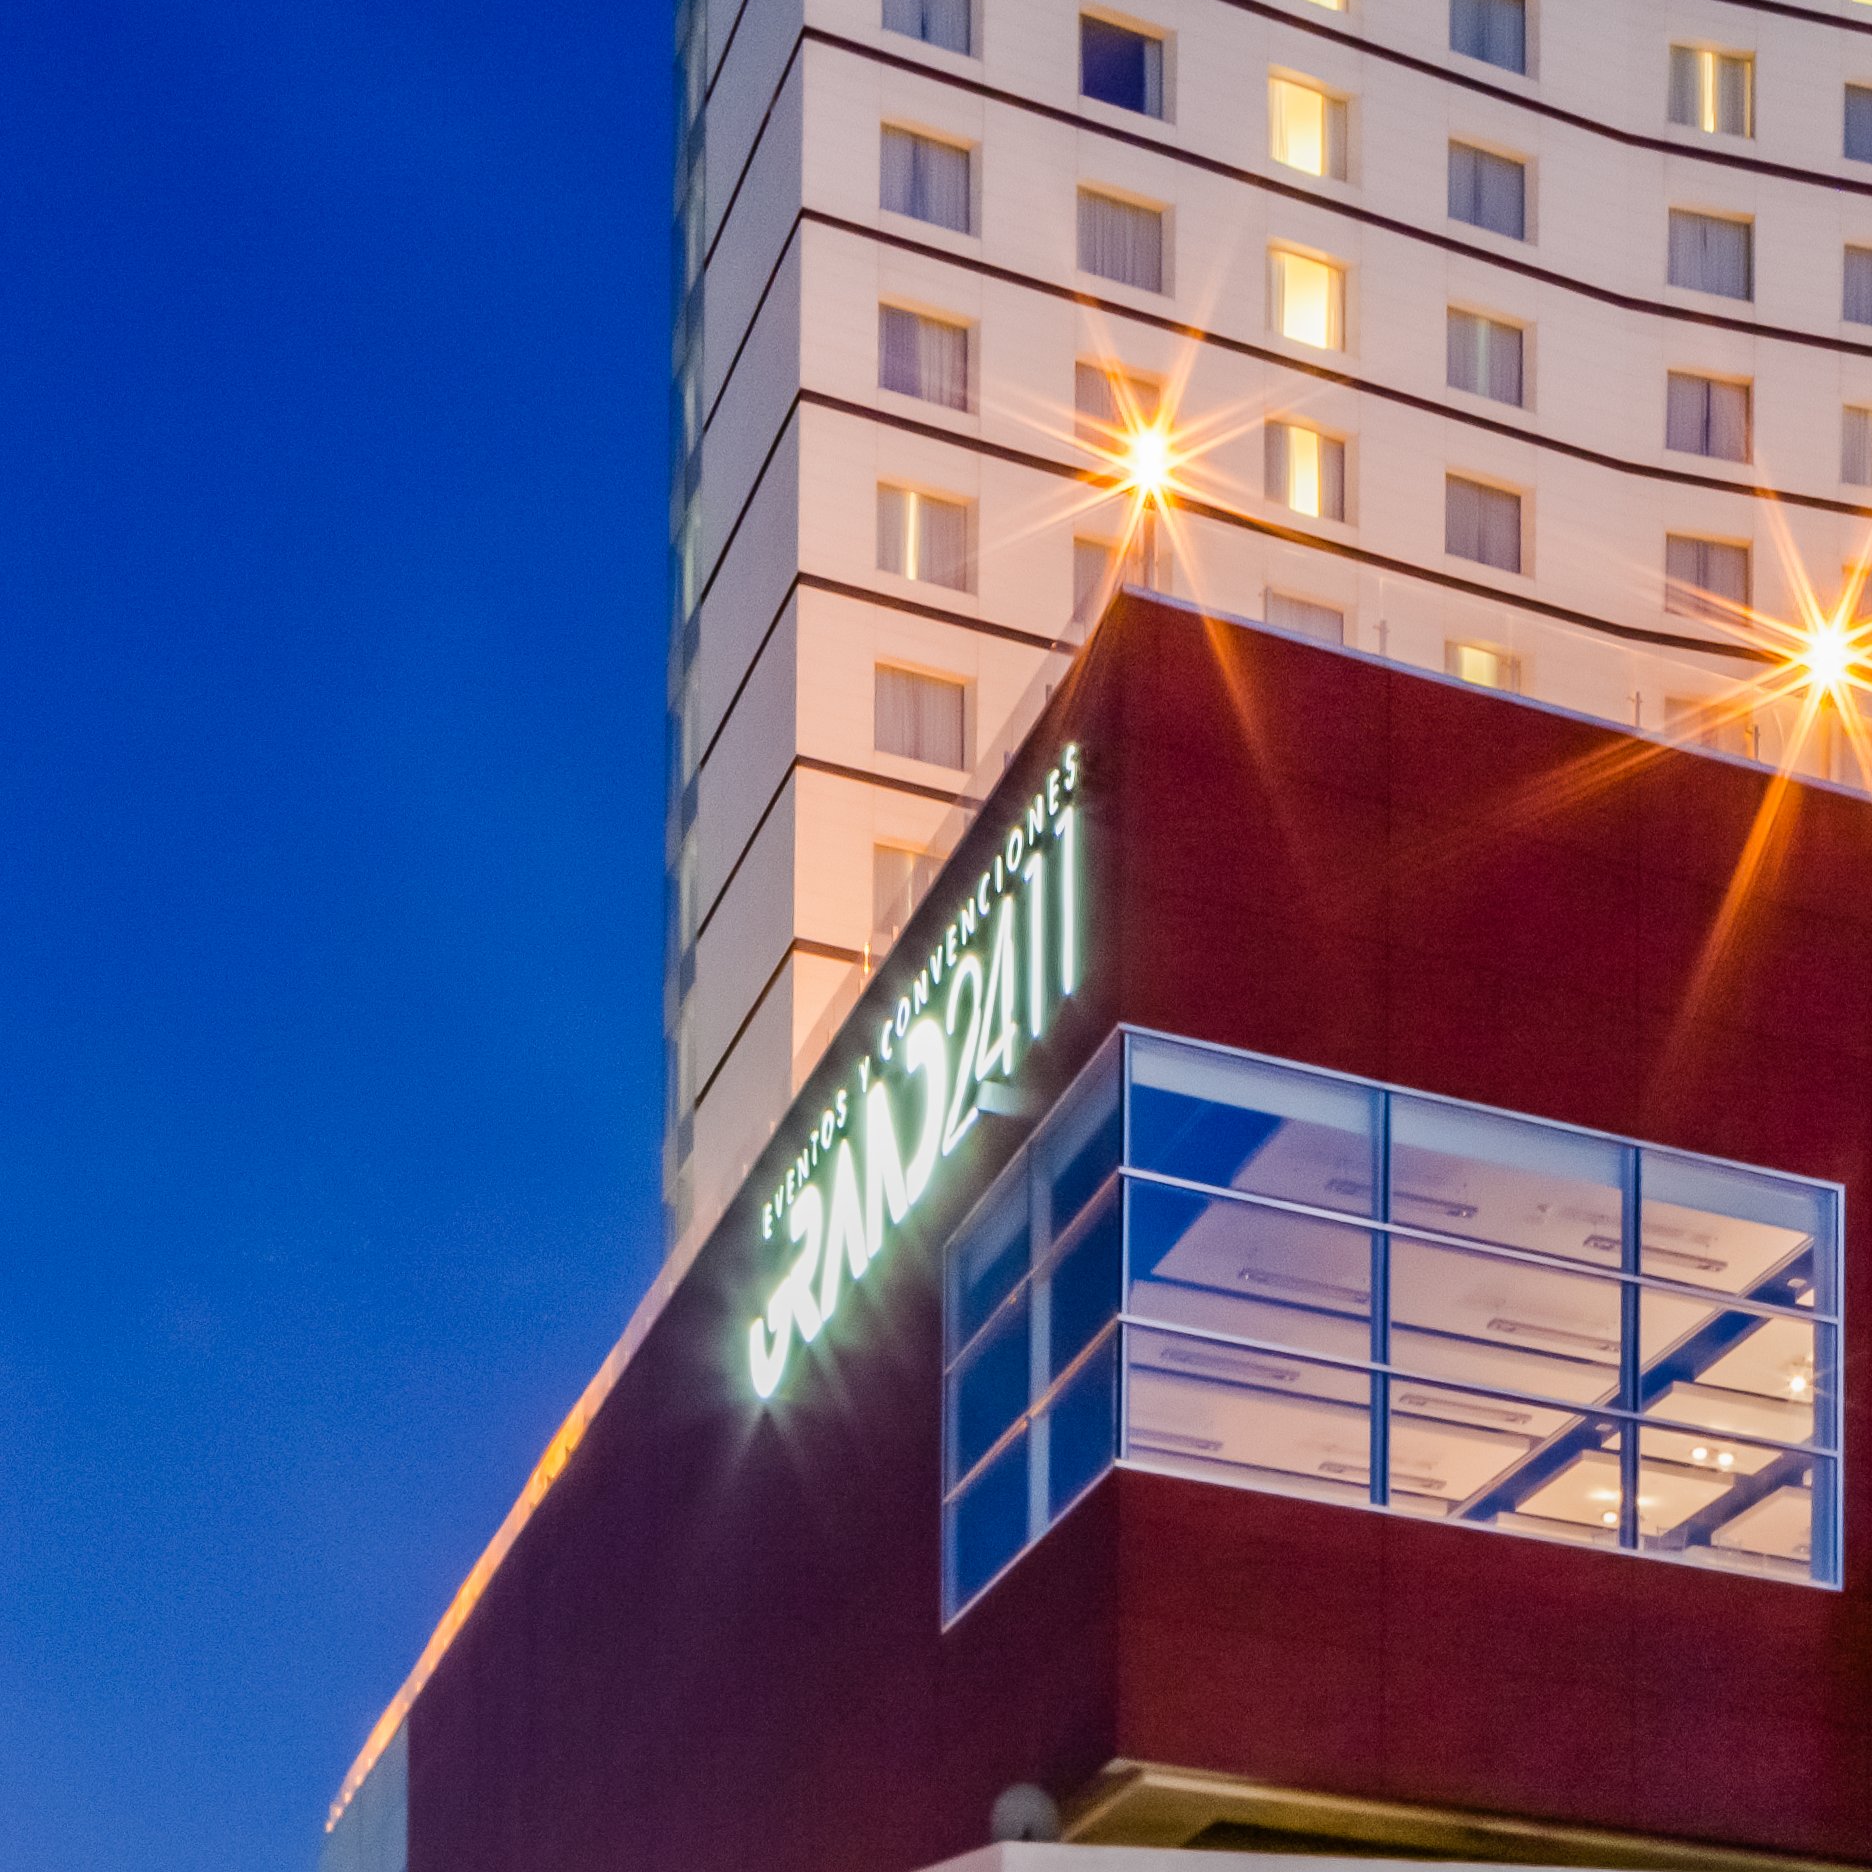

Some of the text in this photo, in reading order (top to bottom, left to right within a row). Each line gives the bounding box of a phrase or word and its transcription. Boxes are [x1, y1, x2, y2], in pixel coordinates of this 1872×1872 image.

[762, 742, 1079, 1240] EVENTOS Y CONVENCIONES
